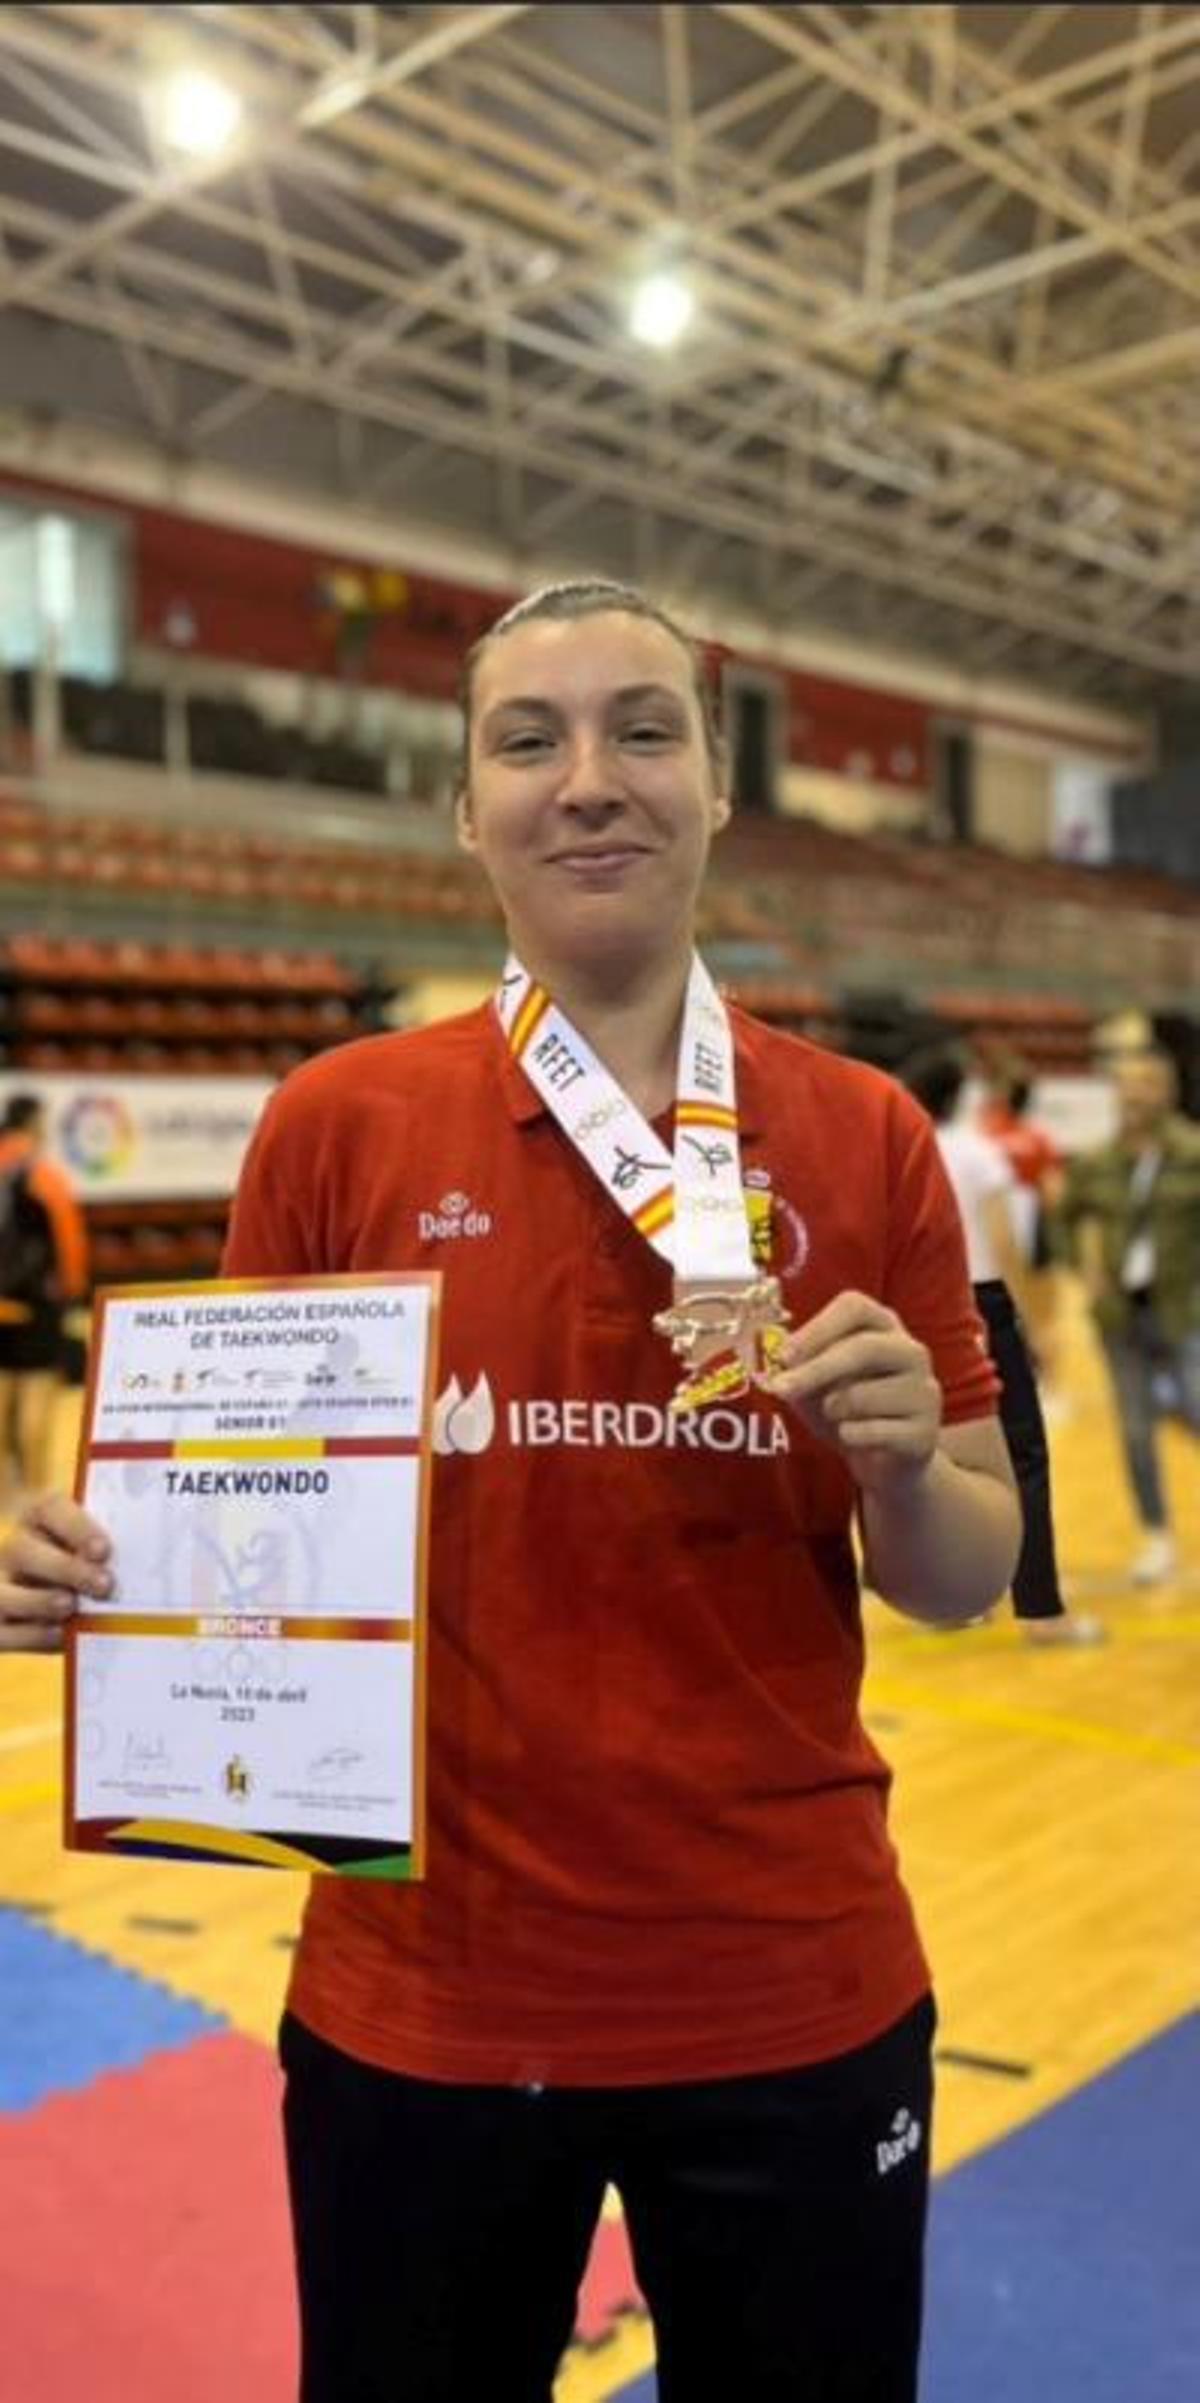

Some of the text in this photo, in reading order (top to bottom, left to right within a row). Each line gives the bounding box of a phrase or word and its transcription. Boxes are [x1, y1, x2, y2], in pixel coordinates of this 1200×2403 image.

[533, 1033, 586, 1092] RFET
[134, 1300, 406, 1328] REAL FEDERACIÓN ESPAÑOLA
[190, 1328, 340, 1349] DE TAEKWONDO
[215, 1415, 264, 1430] SENIOR
[507, 1401, 790, 1457] IBERDROLA
[165, 1470, 330, 1495] TAEKWONDO
[197, 1616, 283, 1637] BRONCE
